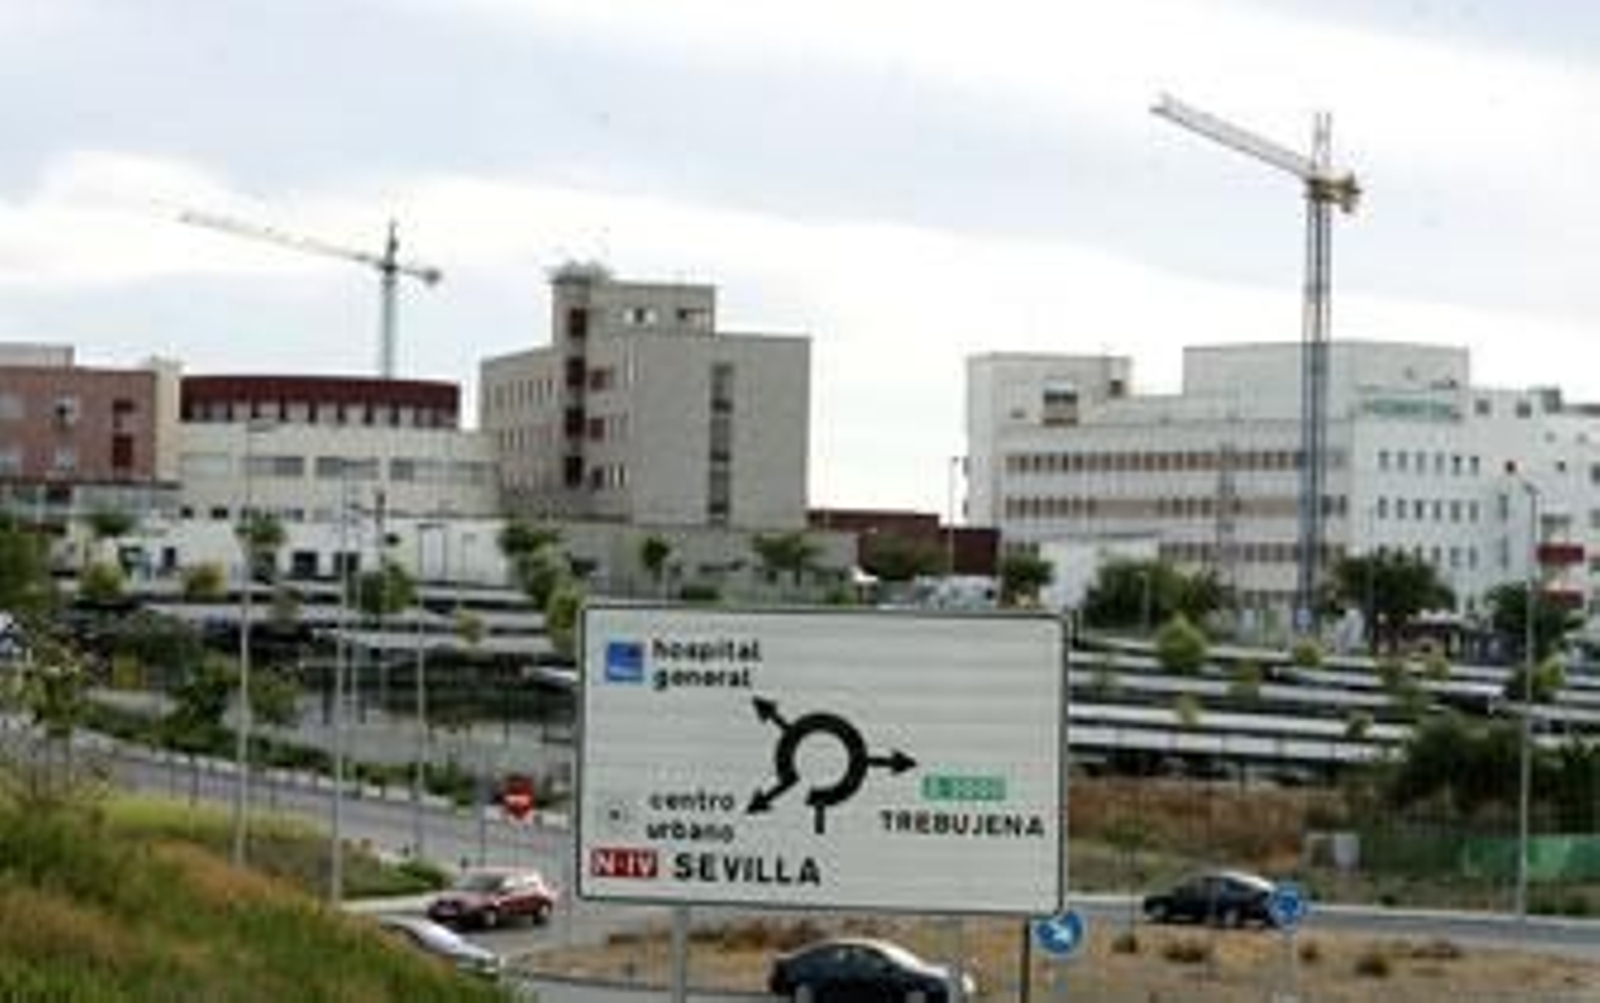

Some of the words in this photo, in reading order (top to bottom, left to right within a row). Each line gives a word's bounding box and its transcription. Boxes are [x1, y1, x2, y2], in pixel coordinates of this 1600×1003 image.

[653, 639, 761, 662] hospital
[653, 668, 752, 690] general
[650, 788, 735, 811] centro
[647, 822, 734, 842] urbano
[881, 811, 1045, 838] TREBUJENA
[673, 853, 821, 883] SEVILLA
